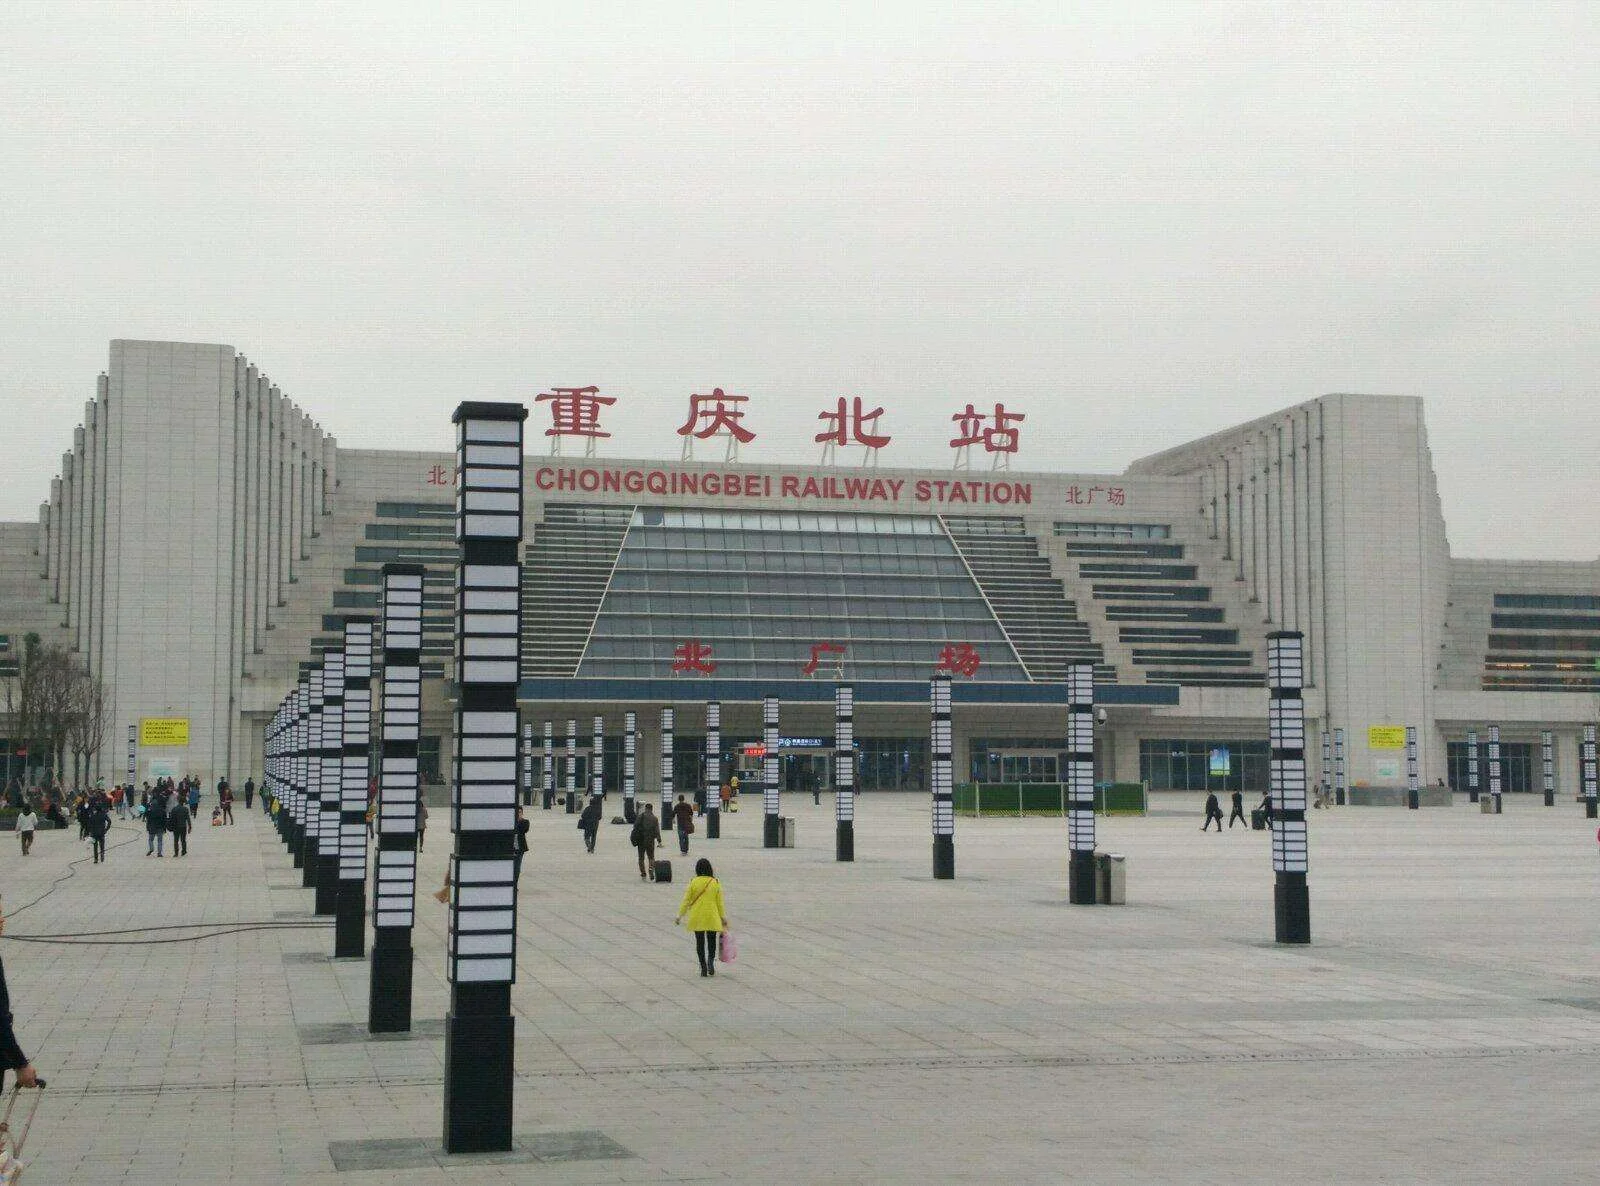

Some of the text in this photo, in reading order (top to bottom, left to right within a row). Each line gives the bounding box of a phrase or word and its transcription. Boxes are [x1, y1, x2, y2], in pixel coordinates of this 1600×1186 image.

[535, 386, 1024, 453] 重庆北站
[535, 469, 1032, 504] CHONGQINGBEI RAILWAY STATION
[1065, 486, 1126, 506] 北广场
[673, 641, 980, 678] 北广场
